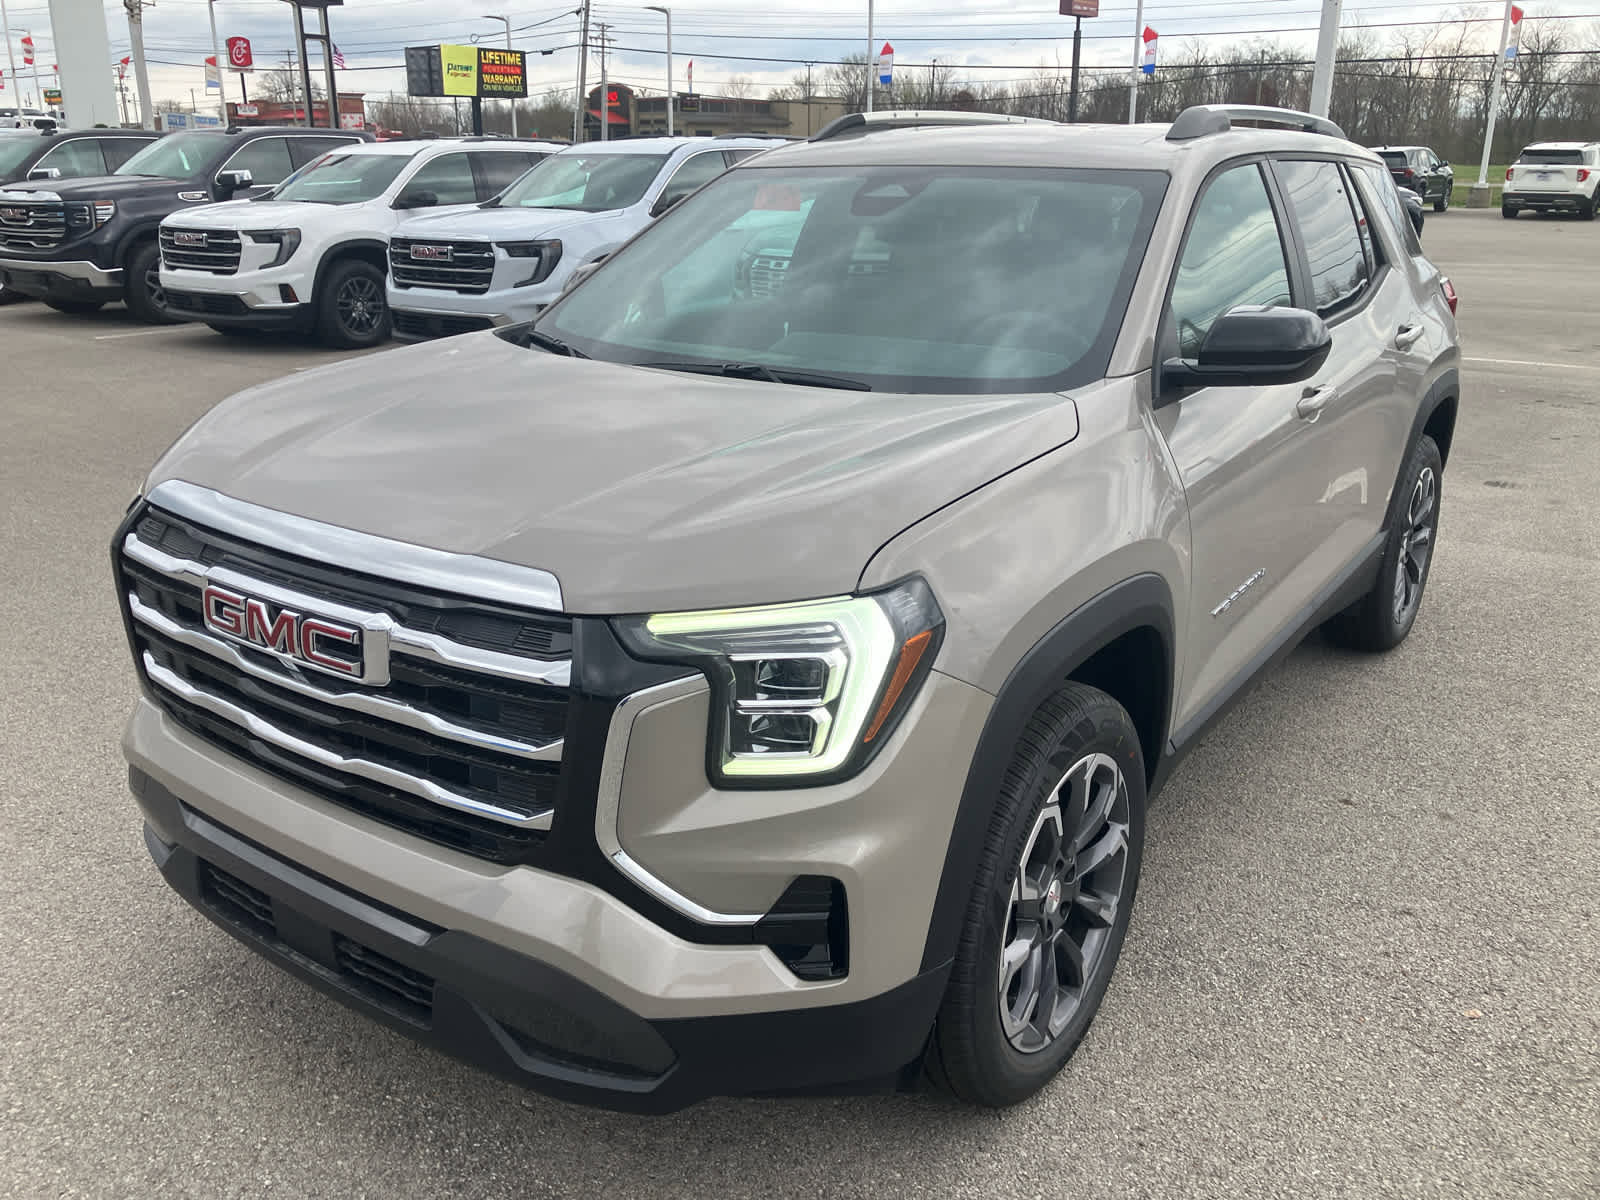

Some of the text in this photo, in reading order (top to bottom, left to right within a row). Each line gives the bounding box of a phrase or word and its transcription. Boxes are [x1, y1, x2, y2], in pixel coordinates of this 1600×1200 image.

[481, 51, 521, 65] LIFETIME
[483, 74, 522, 84] WARRANTY
[412, 247, 447, 259] GMC
[204, 585, 361, 677] GMC
